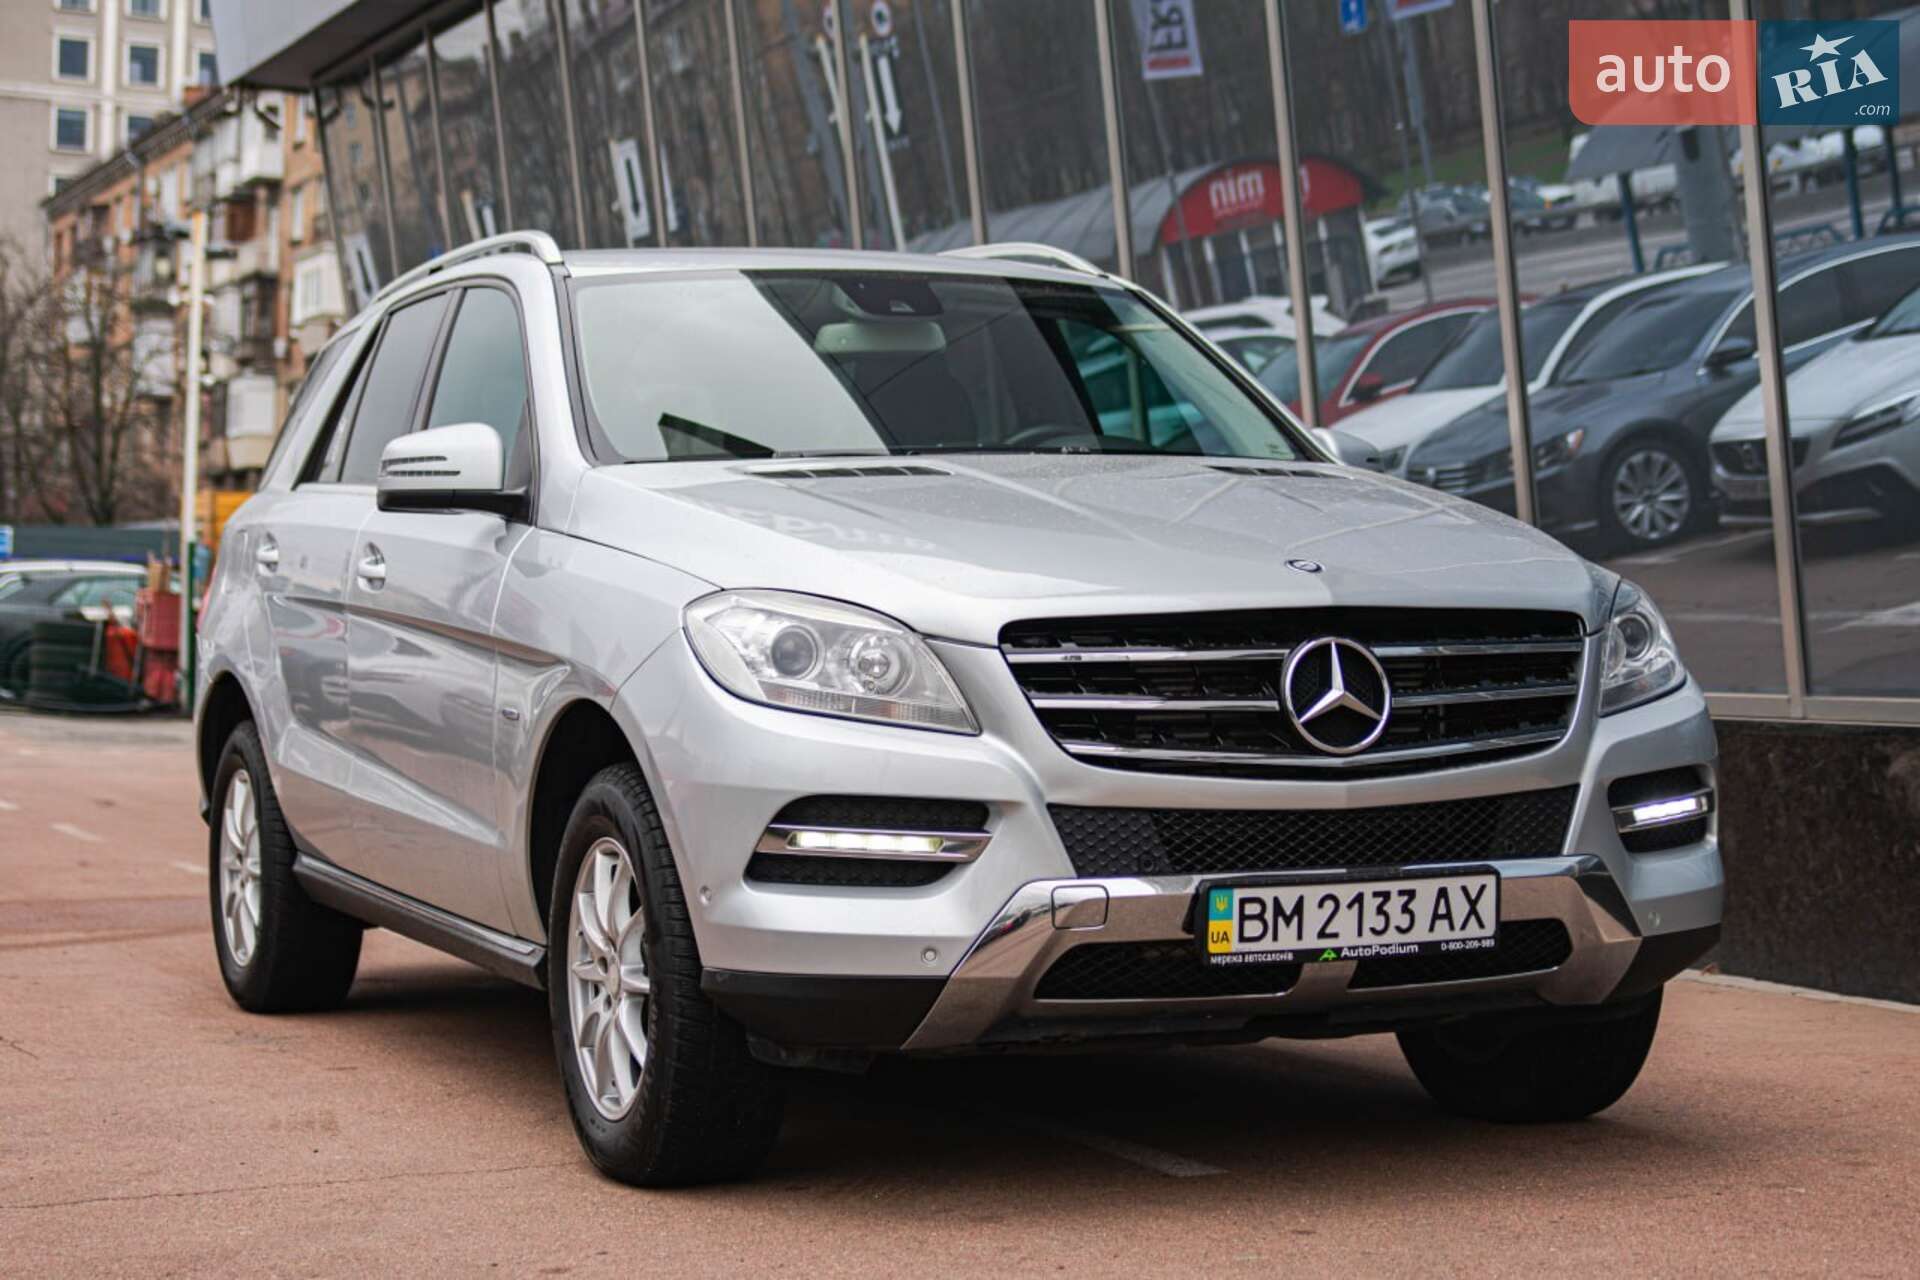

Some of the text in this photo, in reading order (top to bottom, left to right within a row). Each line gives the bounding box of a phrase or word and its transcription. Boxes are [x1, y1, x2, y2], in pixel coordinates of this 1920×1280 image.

[1238, 884, 1487, 943] BM 2133 AX
[1211, 931, 1229, 944] UA
[1340, 944, 1419, 958] AutoPodium
